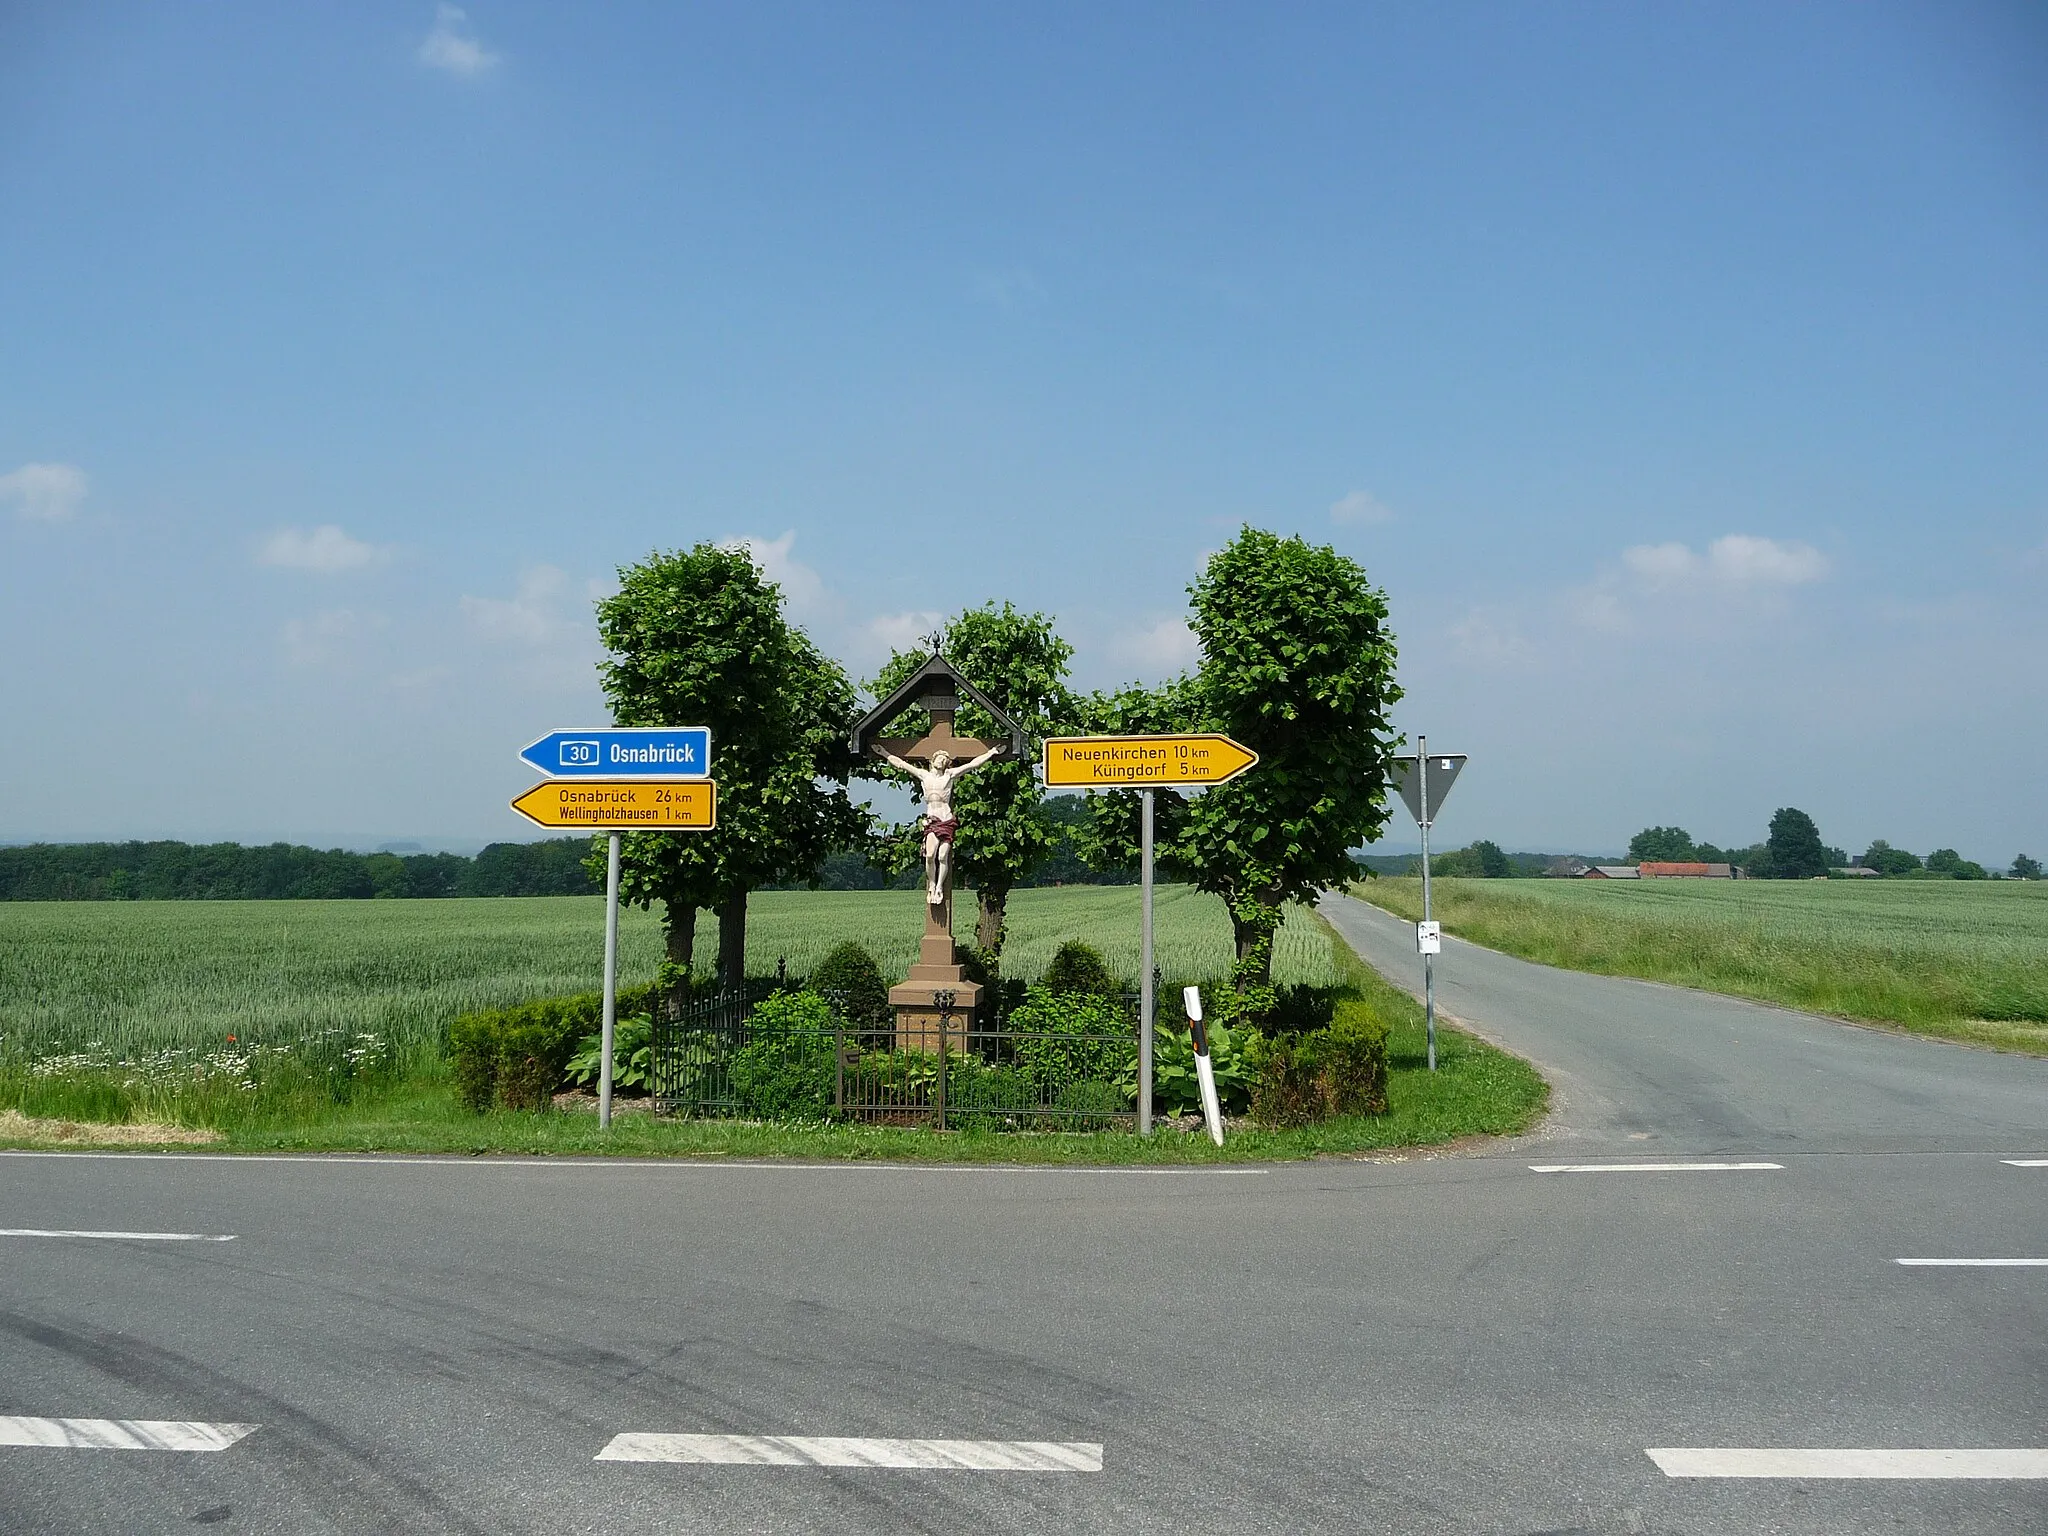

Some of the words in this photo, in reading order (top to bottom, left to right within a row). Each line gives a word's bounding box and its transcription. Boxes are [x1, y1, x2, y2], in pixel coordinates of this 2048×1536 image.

[570, 746, 589, 761] 30
[610, 744, 694, 762] Osnabrück
[1063, 746, 1166, 760] Neuenkirchen
[1173, 745, 1188, 759] 10
[1191, 748, 1209, 758] km
[1093, 763, 1167, 780] Küingdorf
[1180, 762, 1188, 775] 5
[1192, 765, 1210, 775] km
[559, 789, 636, 803] Osnabrück
[656, 790, 672, 802] 26
[675, 793, 692, 802] km
[559, 807, 658, 822] Wellingholzhausen
[665, 807, 670, 819] 1
[675, 810, 692, 819] km
